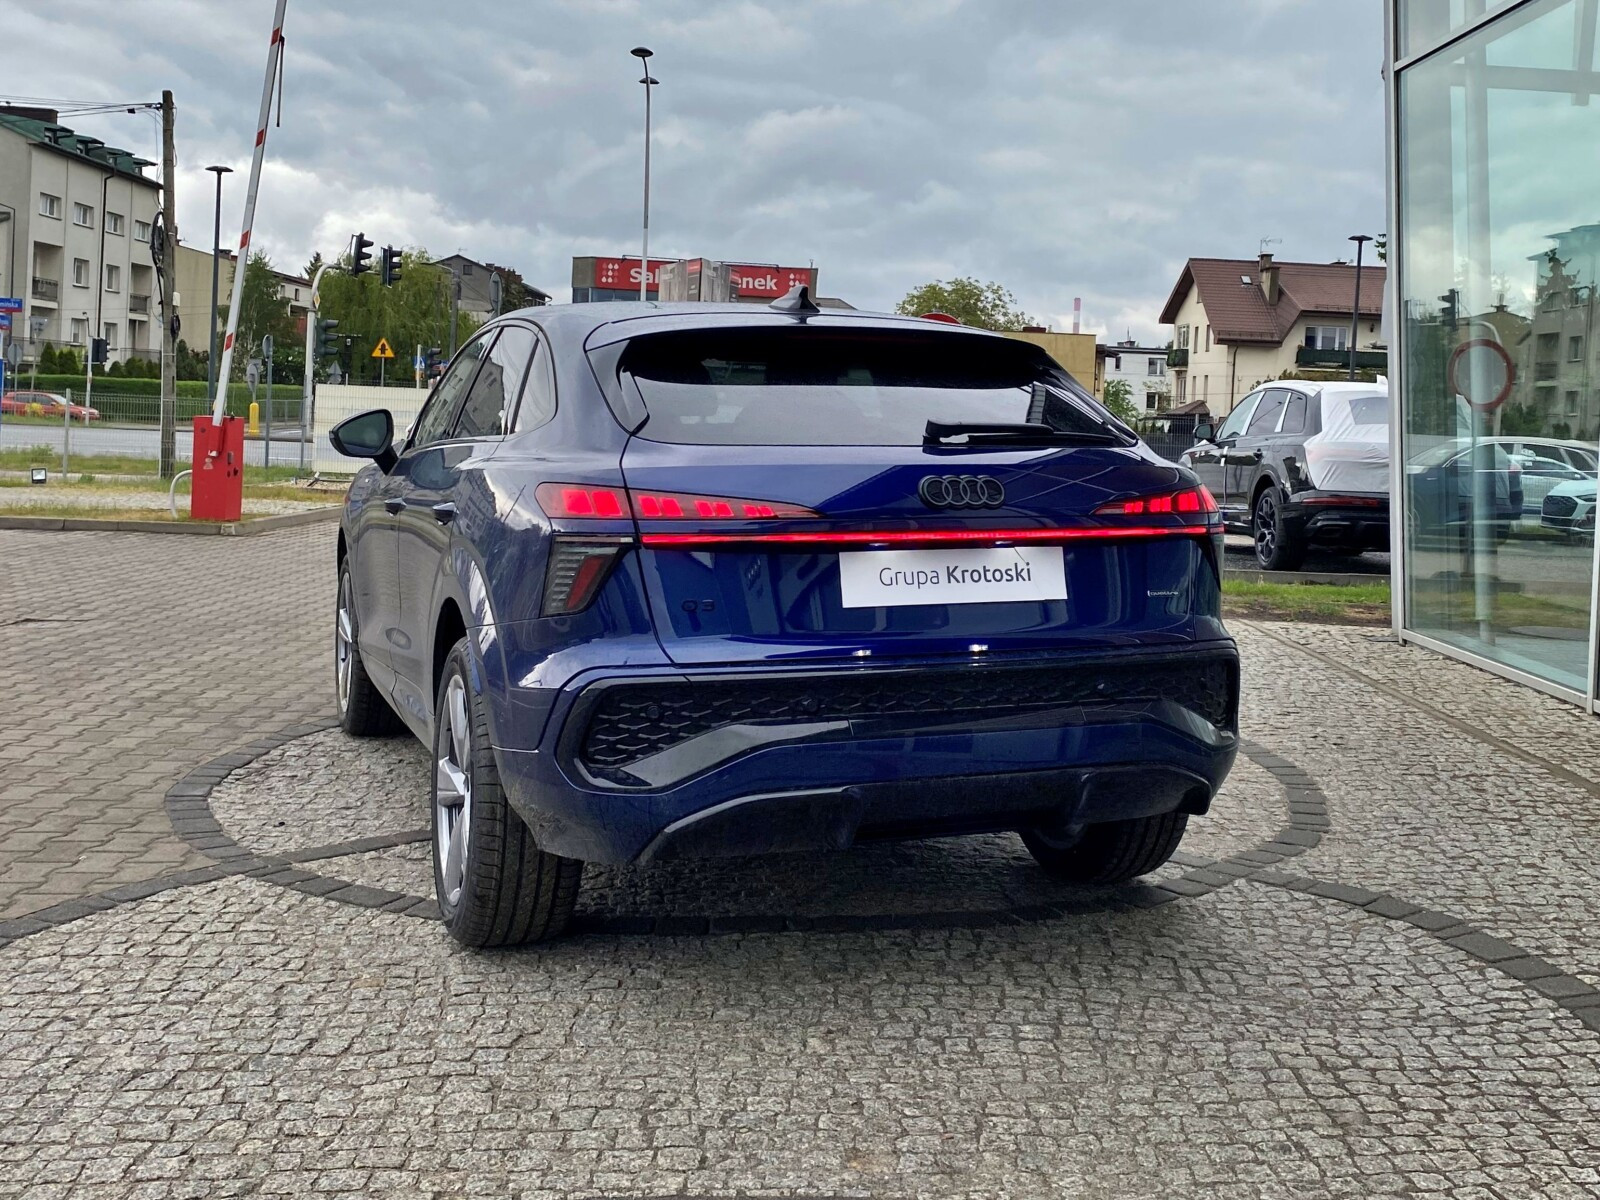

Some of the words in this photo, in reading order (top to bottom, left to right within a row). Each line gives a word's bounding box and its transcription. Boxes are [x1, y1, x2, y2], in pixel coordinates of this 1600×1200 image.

[879, 567, 940, 589] Grupa
[946, 562, 1032, 584] Krotoski
[682, 599, 715, 612] Q3
